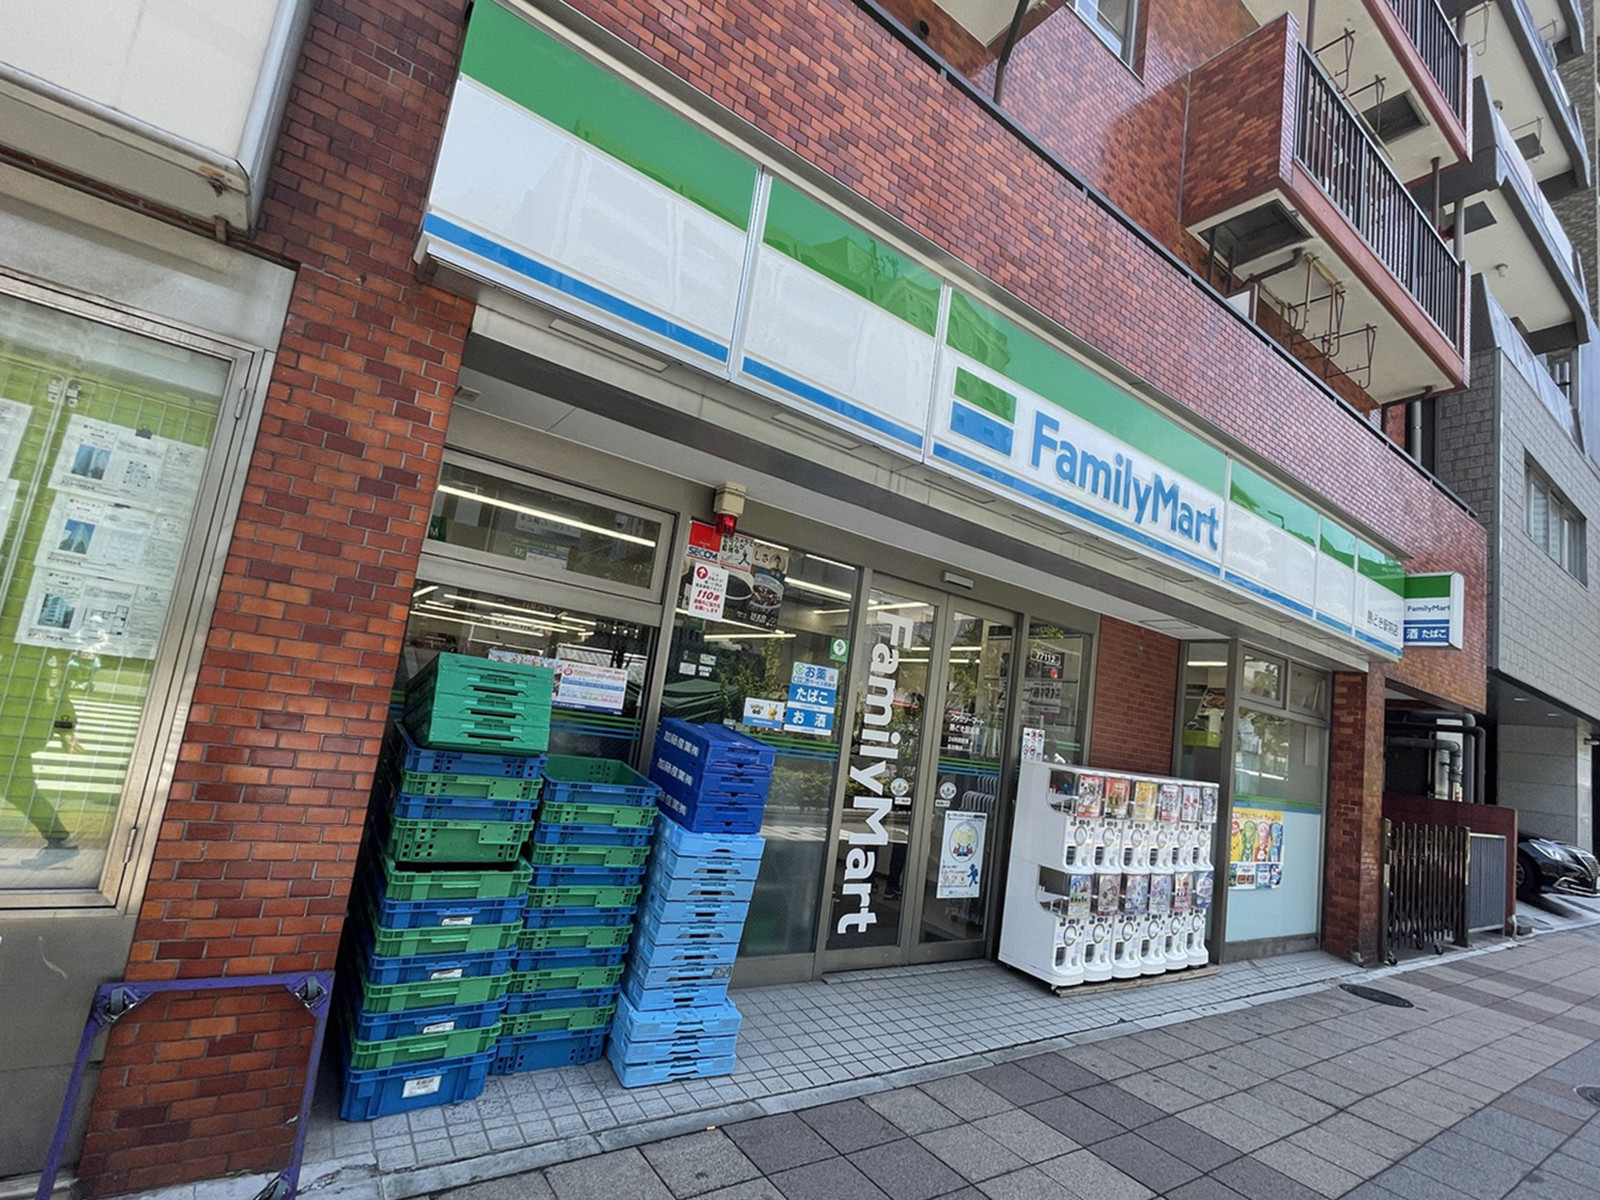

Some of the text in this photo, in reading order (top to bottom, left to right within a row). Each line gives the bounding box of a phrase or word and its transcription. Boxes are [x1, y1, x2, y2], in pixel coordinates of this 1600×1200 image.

[1031, 411, 1219, 551] FamilyMart
[687, 546, 718, 561] SECOM
[1407, 604, 1451, 614] FamilyMart
[1422, 629, 1448, 639] たばこ
[805, 666, 827, 681] お薬
[795, 687, 829, 705] たばこ
[837, 611, 914, 935] FamilyMart
